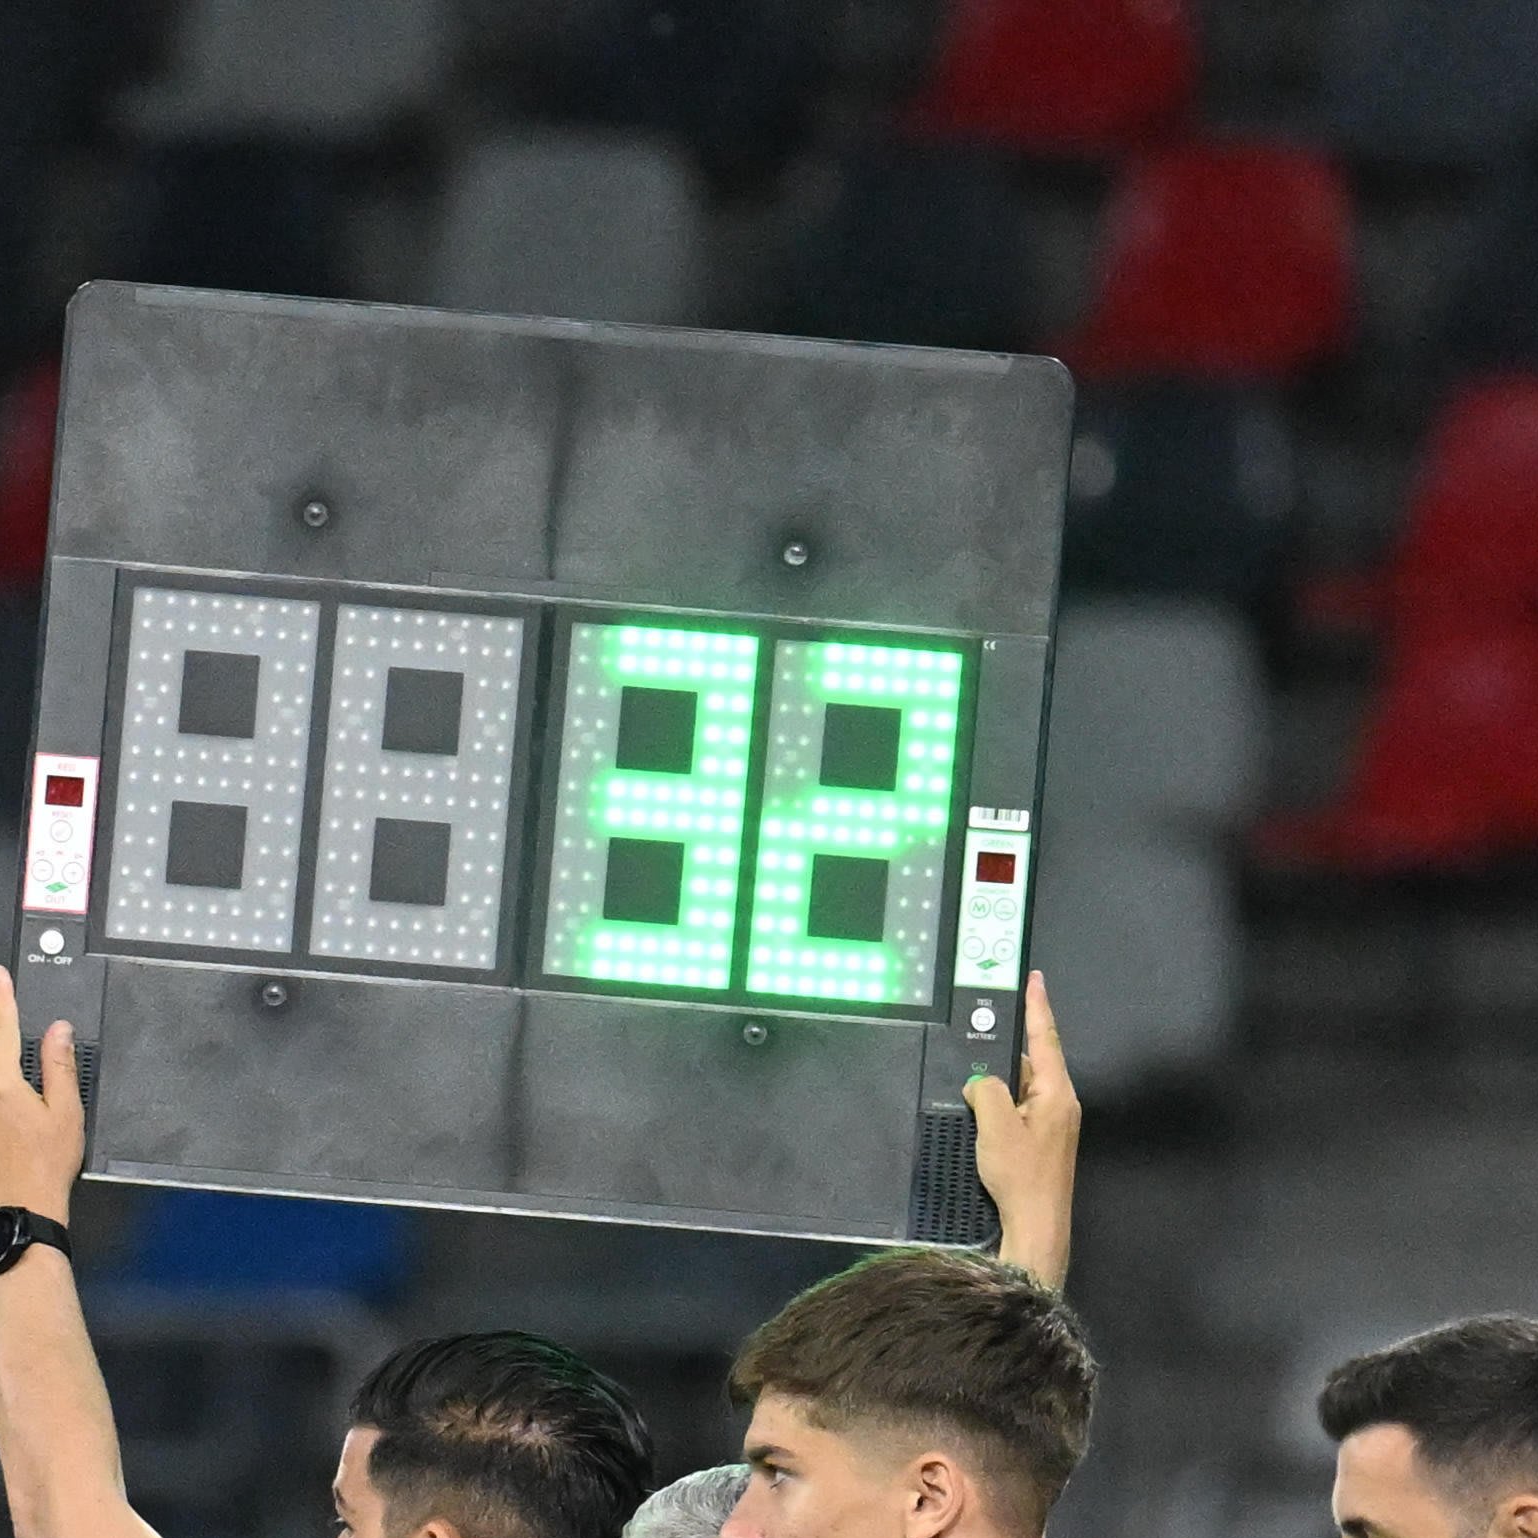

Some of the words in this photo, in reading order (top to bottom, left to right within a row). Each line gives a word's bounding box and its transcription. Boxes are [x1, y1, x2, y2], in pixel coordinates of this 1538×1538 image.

[588, 622, 964, 1004] 32
[27, 953, 46, 964] ON
[53, 955, 74, 967] OFF
[971, 1062, 988, 1072] GO
